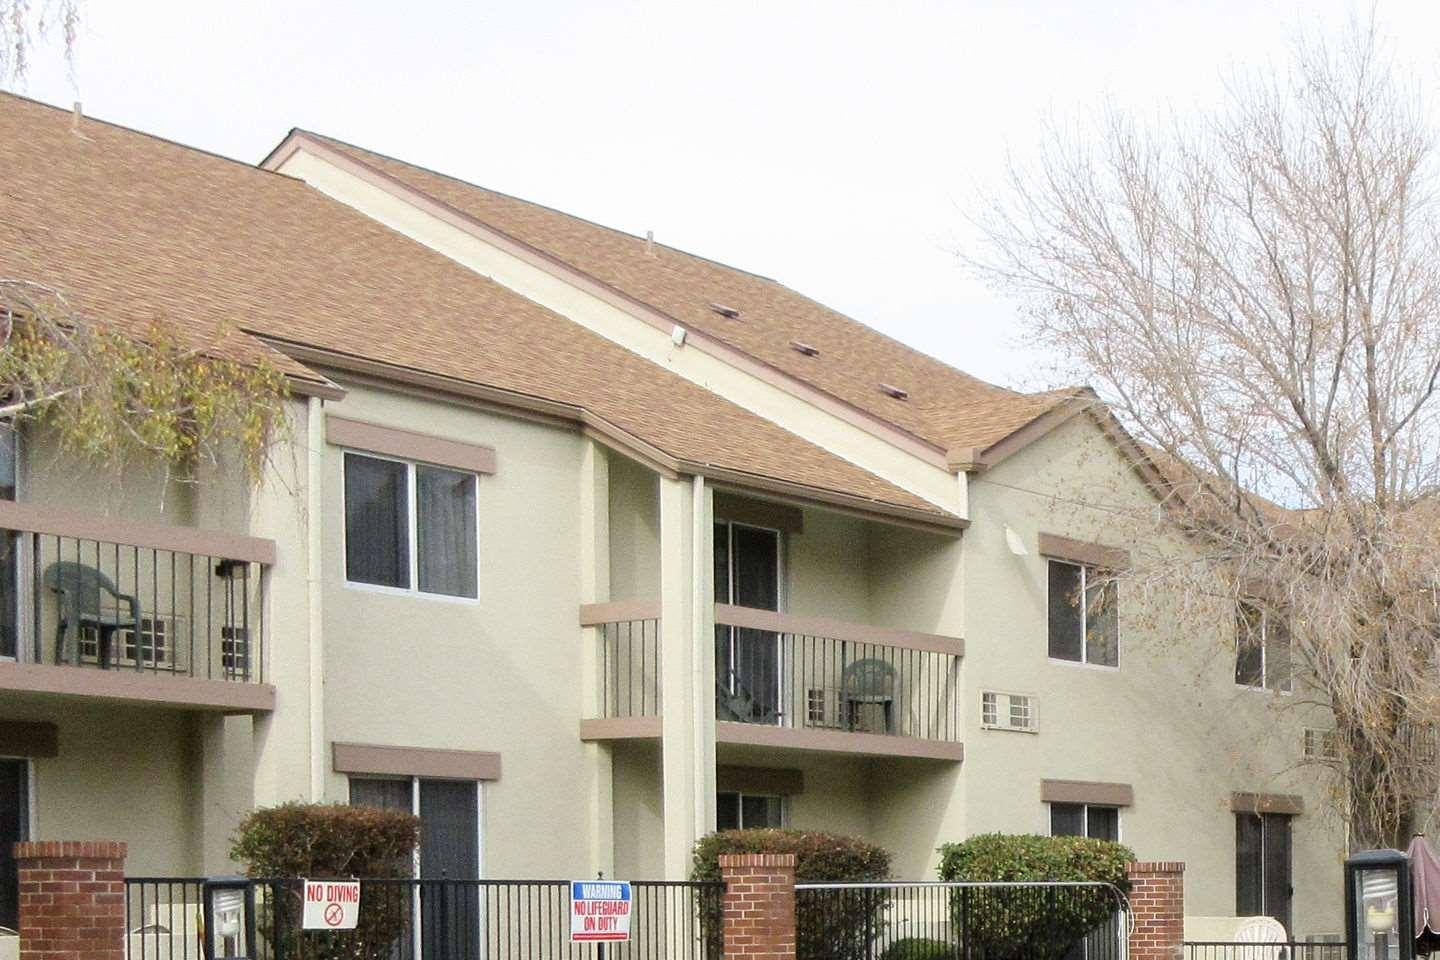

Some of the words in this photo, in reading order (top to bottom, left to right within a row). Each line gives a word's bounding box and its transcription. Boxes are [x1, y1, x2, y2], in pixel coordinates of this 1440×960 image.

[307, 884, 323, 902] NO
[327, 885, 358, 903] DIVING
[582, 884, 622, 899] WARNING
[575, 901, 585, 915] NO
[587, 901, 628, 915] LIFEGUARD
[584, 916, 595, 931] ON
[598, 917, 617, 931] DUTY
